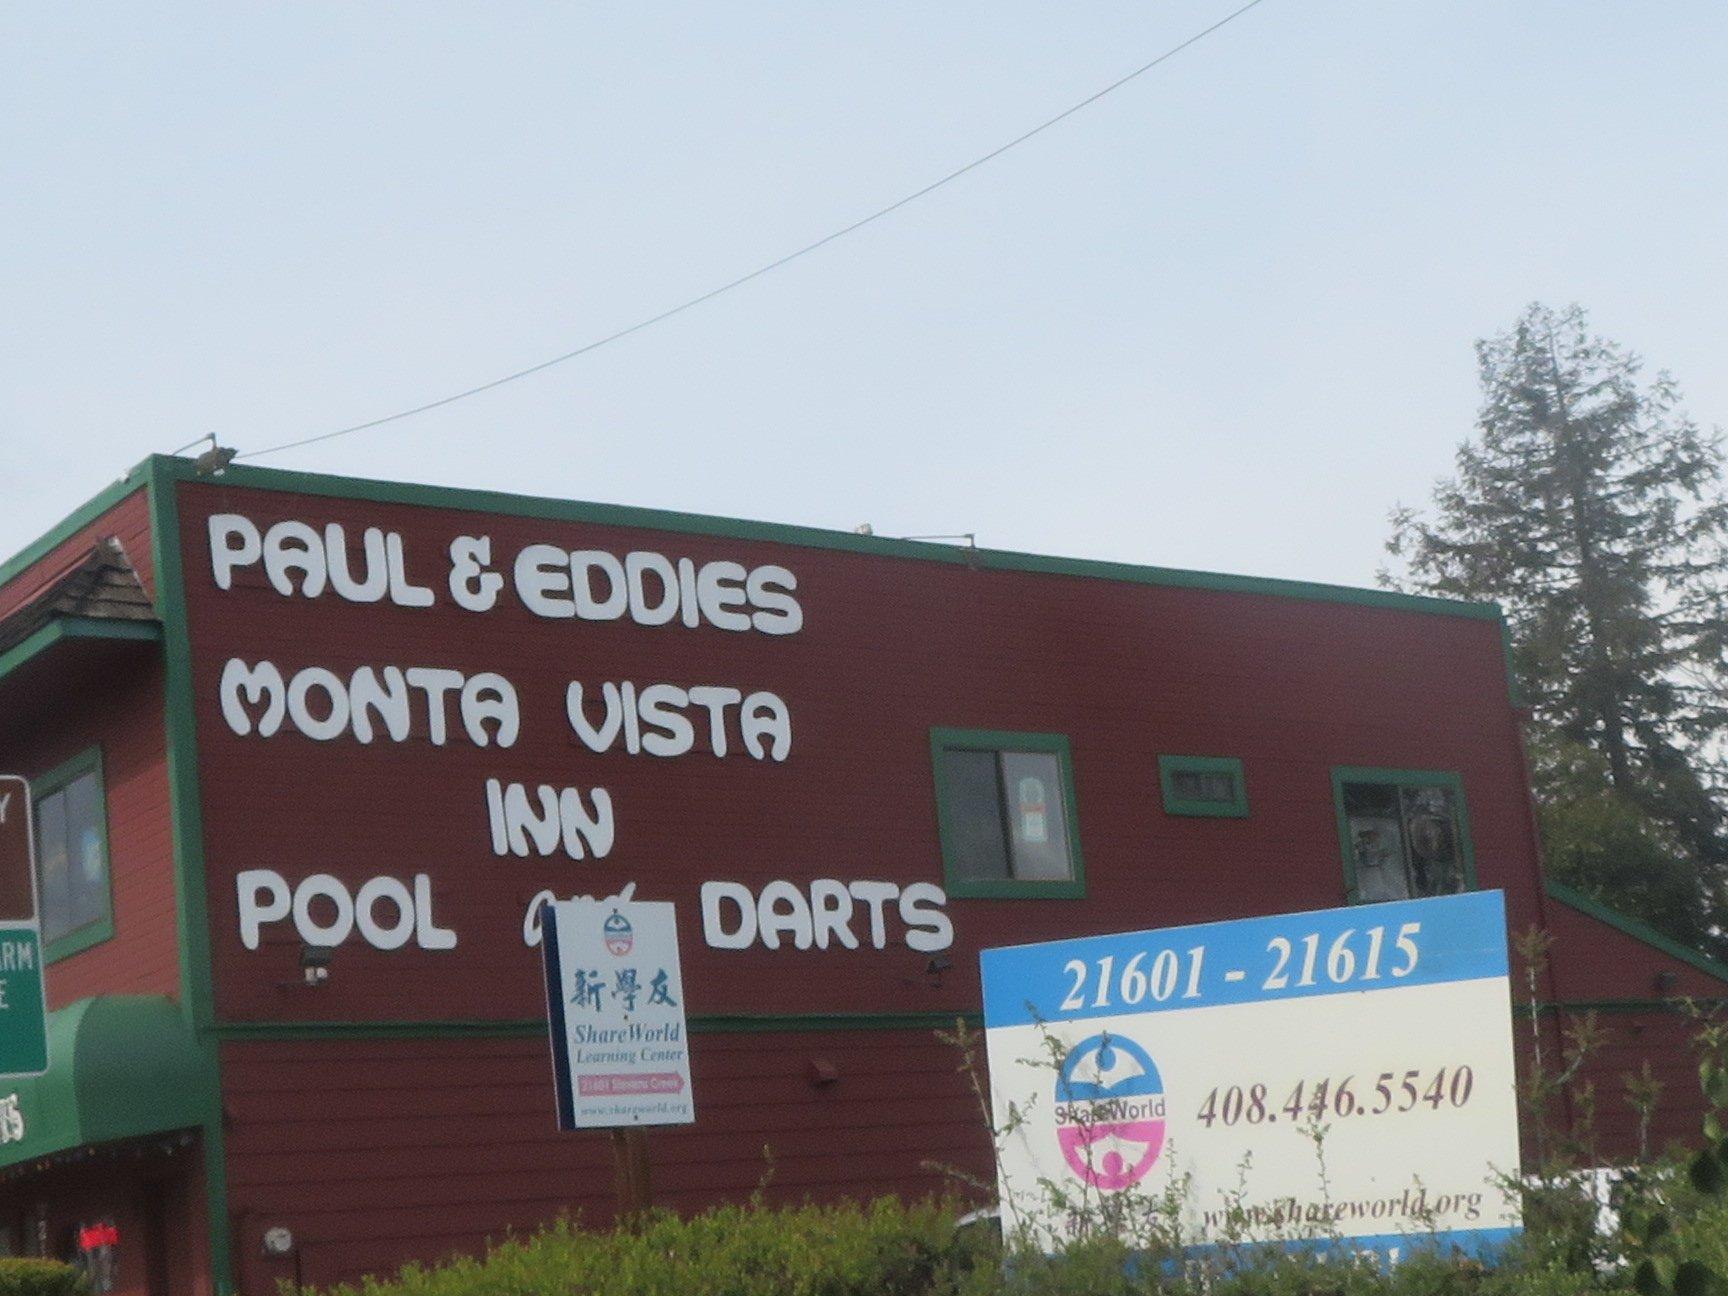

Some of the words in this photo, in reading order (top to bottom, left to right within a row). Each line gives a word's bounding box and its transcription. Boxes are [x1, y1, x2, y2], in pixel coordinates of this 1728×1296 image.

[209, 514, 434, 606] PAUL
[450, 536, 504, 612] &
[514, 544, 803, 635] EDDIES
[220, 658, 519, 748] MONTA
[566, 680, 791, 761] VISTA
[486, 779, 613, 860] INN
[237, 870, 457, 951] POOL
[701, 879, 954, 951] DARTS
[1059, 945, 1206, 1011] 21601
[1224, 969, 1246, 983] -
[1262, 921, 1421, 991] 21615
[576, 1048, 636, 1064] Learning
[640, 1047, 683, 1062] Center
[1197, 1065, 1473, 1128] 408.446.5540
